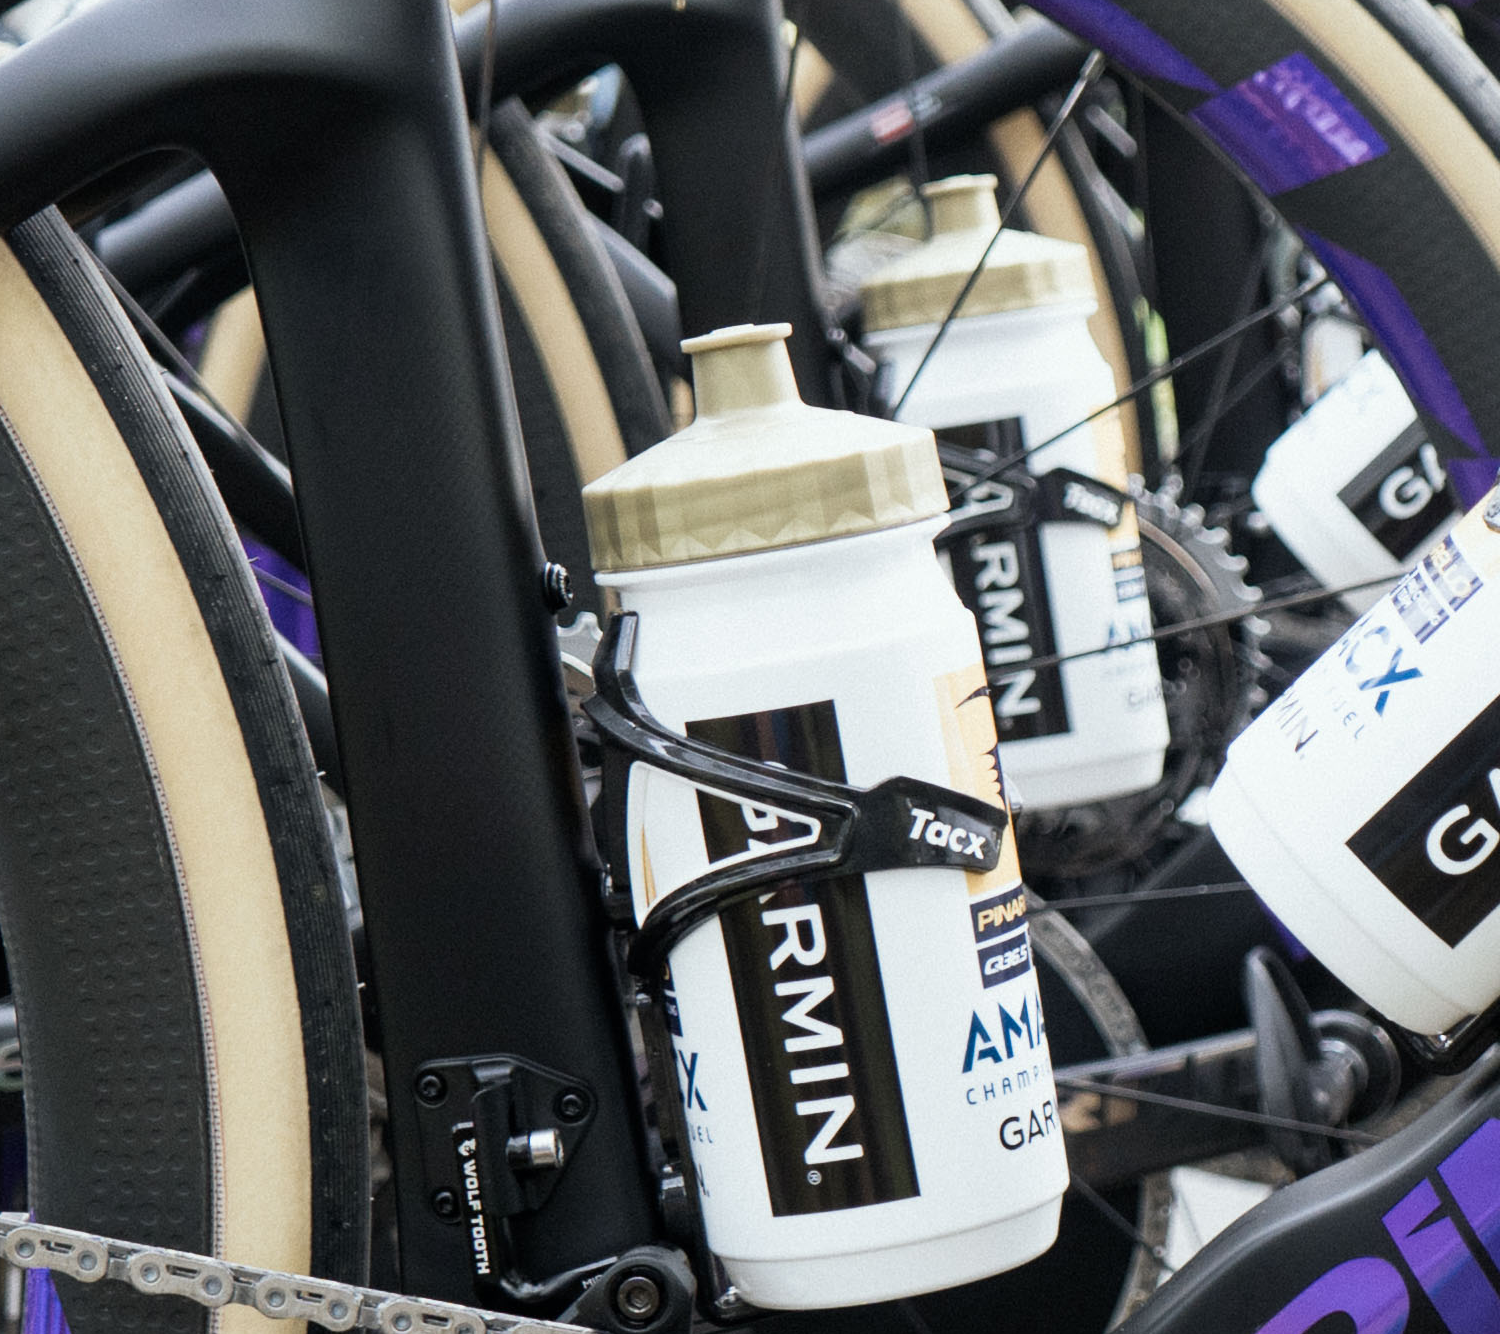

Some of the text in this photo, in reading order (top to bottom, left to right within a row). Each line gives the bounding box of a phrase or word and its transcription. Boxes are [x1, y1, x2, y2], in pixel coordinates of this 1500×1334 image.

[908, 808, 987, 861] Tacx
[462, 1158, 492, 1275] WOLF TOOTH
